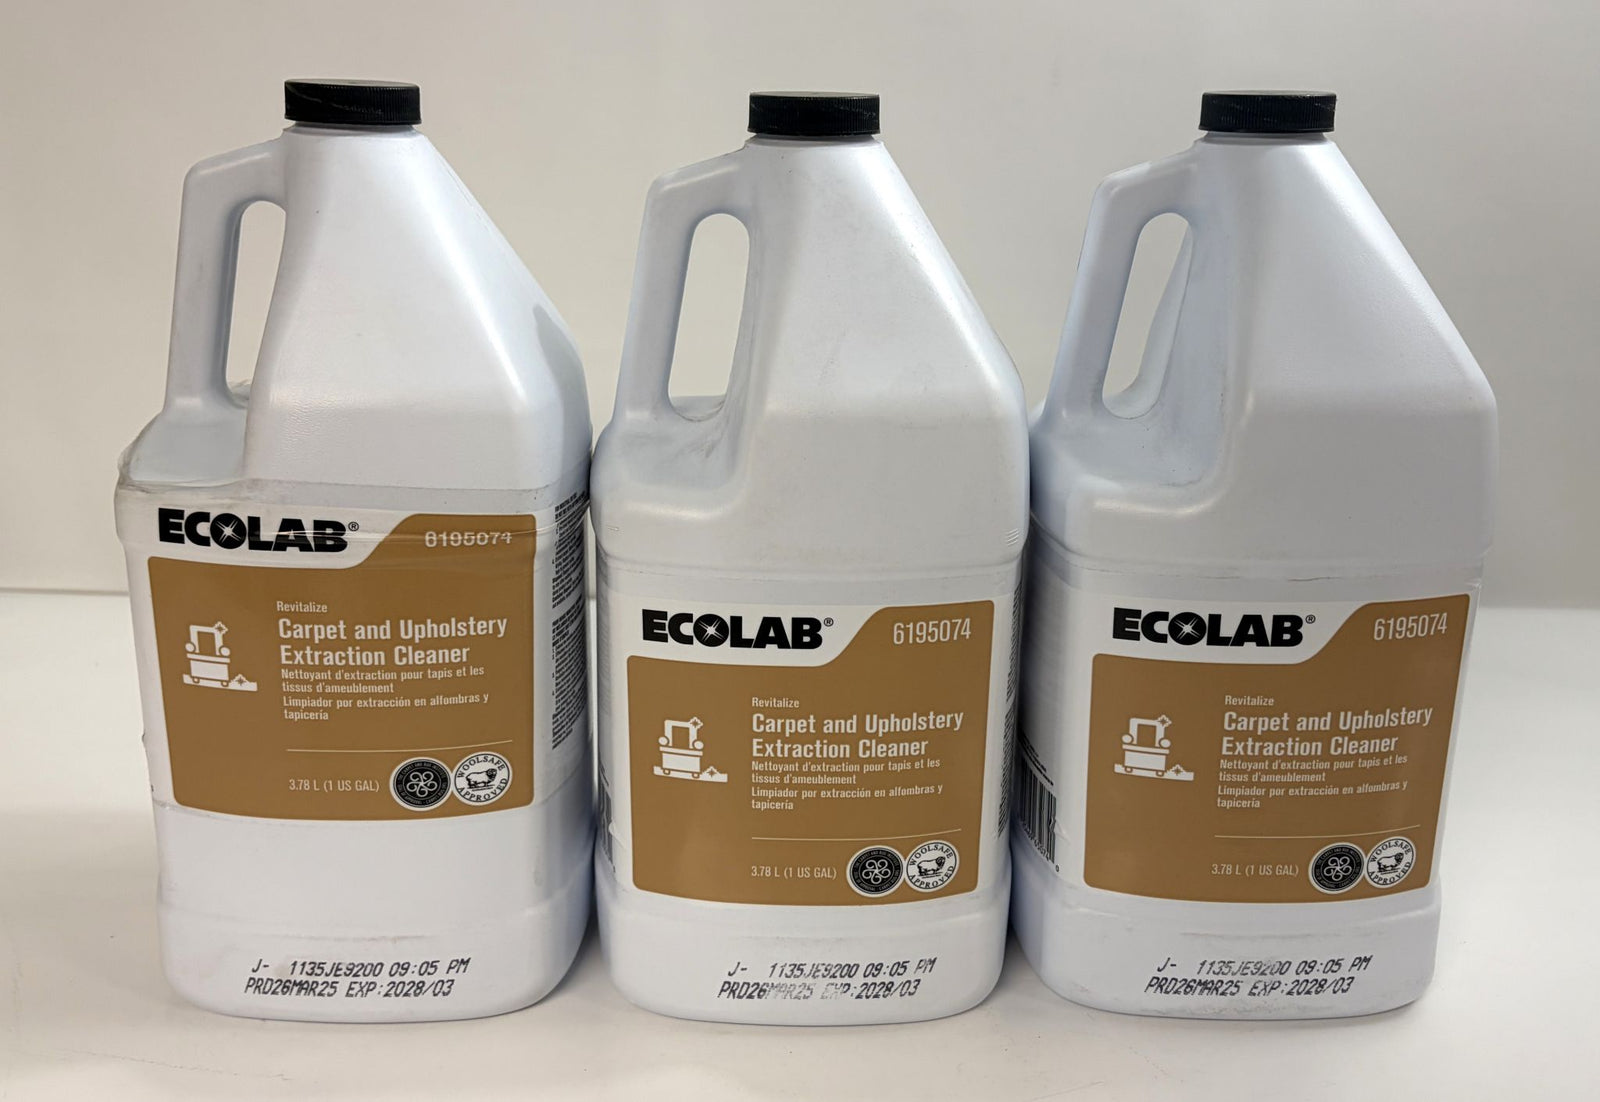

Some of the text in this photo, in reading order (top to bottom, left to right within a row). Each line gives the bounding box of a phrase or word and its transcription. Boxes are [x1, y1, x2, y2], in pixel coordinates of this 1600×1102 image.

[276, 600, 328, 613] Revitalize
[278, 616, 508, 643] Carpet and Upholstery
[892, 617, 972, 646] 6195074
[1373, 612, 1448, 641] 6195074
[279, 645, 470, 666] Extraction Cleaner
[281, 665, 485, 682] Nettoyant d'extraction pour tapis et les
[282, 682, 395, 694] tissus d'ameublement
[283, 693, 489, 710] Limpiador por extracción en alfombras y
[751, 697, 800, 708] Revitalize
[1224, 695, 1275, 706] Revitalize
[752, 710, 964, 737] Carpet and Upholstery
[1223, 706, 1433, 735] Carpet and Upholstery
[752, 738, 929, 758] Extraction Cleaner
[1221, 735, 1399, 756] Extraction Cleaner
[457, 755, 506, 778] WOOLSAFE
[751, 758, 941, 774] Nettoyant d'extraction pour tapis et les
[1219, 753, 1408, 771] Nettoyant d'extraction pour tapis et les
[288, 779, 380, 793] 3.78 L (1 US GAL)
[751, 773, 857, 785] tissus d'ameublement
[1219, 771, 1326, 783] tissus d'ameublement
[456, 777, 508, 802] APPROVED
[751, 784, 944, 799] Limpiador por extracción en alfombras y
[1217, 780, 1408, 798] Limpiador por extracción en alfombras y
[909, 843, 954, 866] WOOLSAFE
[1369, 839, 1413, 862] WOOLSAFE
[751, 865, 837, 880] 3.78 L (1 US GAL)
[908, 865, 955, 890] APPROVED
[1211, 863, 1299, 877] 3.78 L (1 US GAL)
[1368, 861, 1411, 885] APPROVED
[289, 960, 384, 978] 1135JE9200
[388, 960, 441, 977] 09:05
[445, 957, 471, 975] PM
[863, 960, 910, 978] 09:05
[913, 957, 938, 975] PM
[1294, 958, 1345, 976] 09:05
[1348, 954, 1374, 973] PM
[244, 977, 455, 998] PRD26MAR25 EXP:2028/03
[1144, 976, 1355, 997] PRD26MAR25 EXP:2028/03
